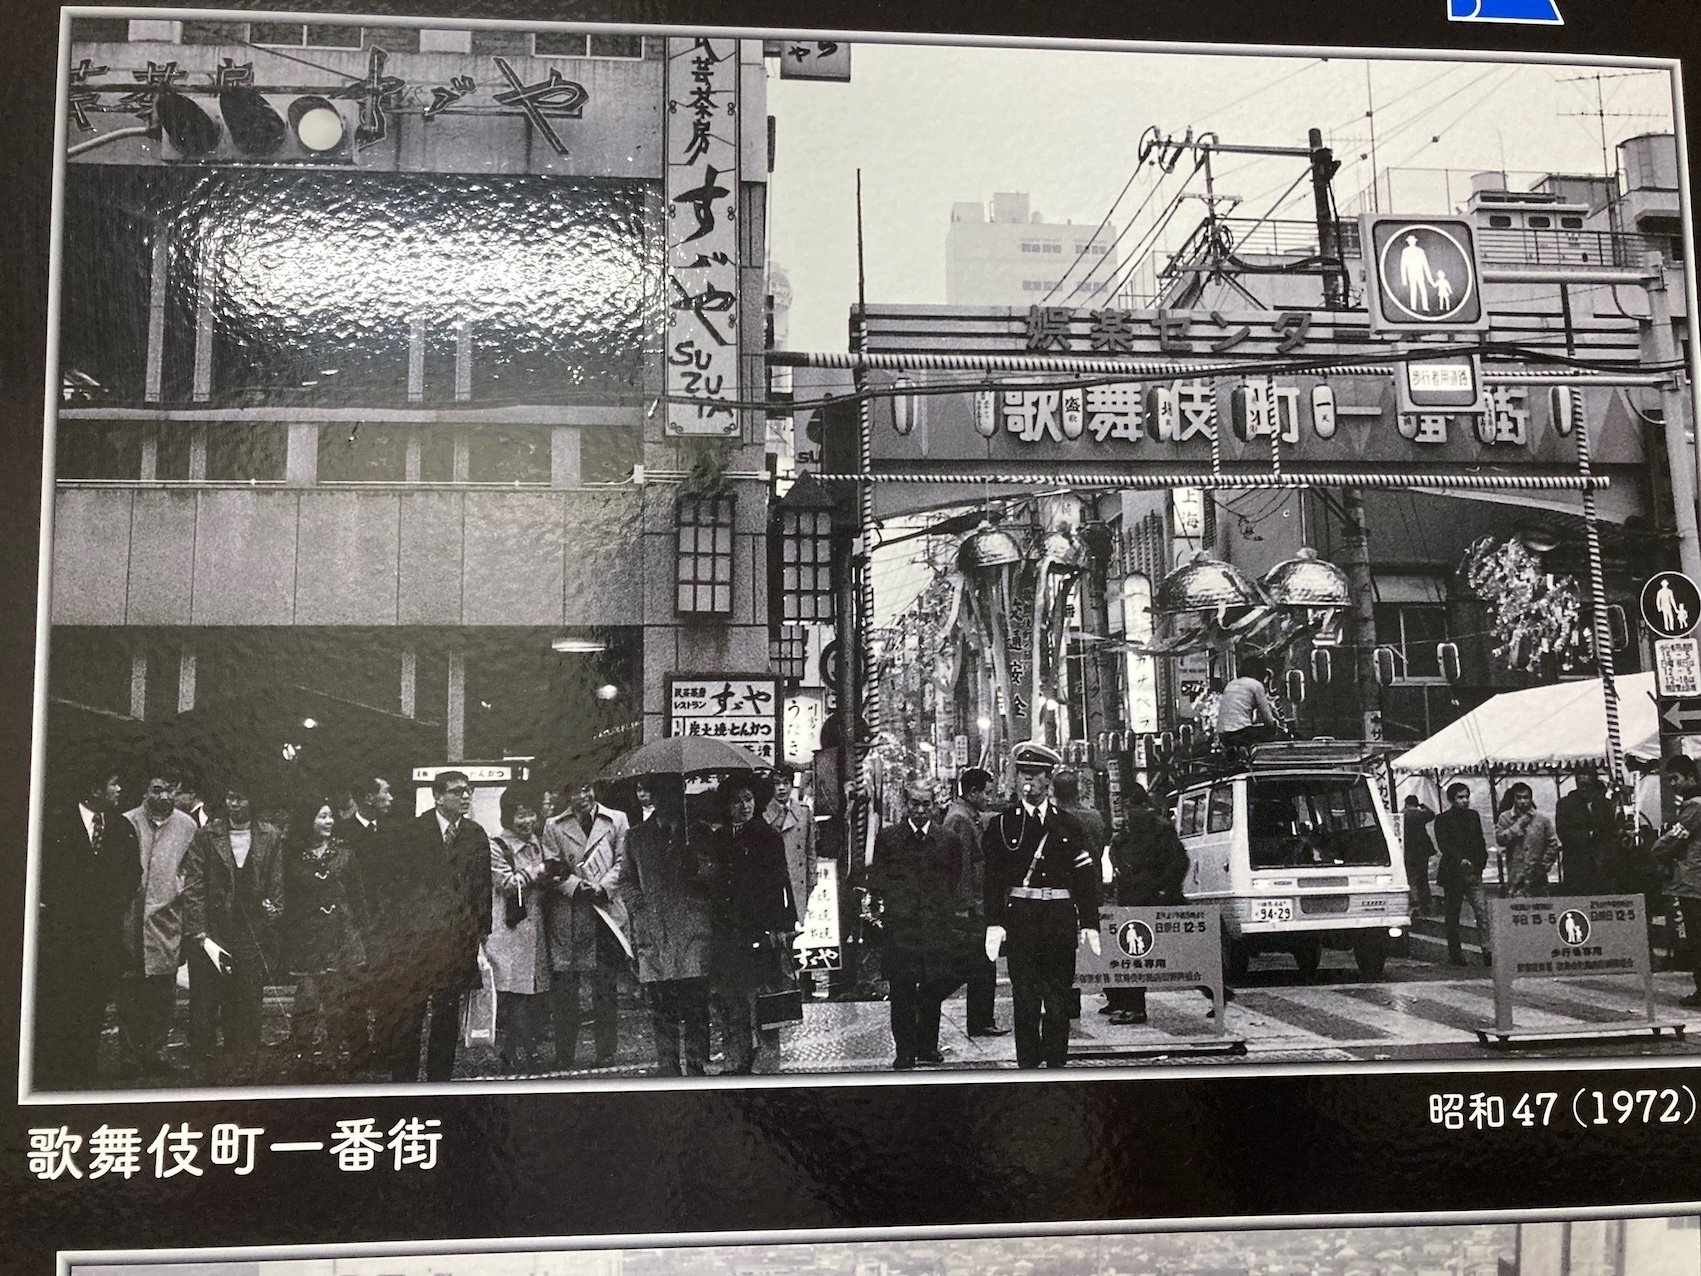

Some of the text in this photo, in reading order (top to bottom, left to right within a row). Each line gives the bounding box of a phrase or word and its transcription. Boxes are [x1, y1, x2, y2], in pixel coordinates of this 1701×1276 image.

[1025, 304, 1372, 353] 娯楽センター
[668, 340, 712, 371] SU
[680, 371, 723, 395] ZU
[1182, 489, 1200, 529] 上海
[674, 701, 707, 710] レストラン
[25, 1116, 443, 1180] 歌舞伎町一番街
